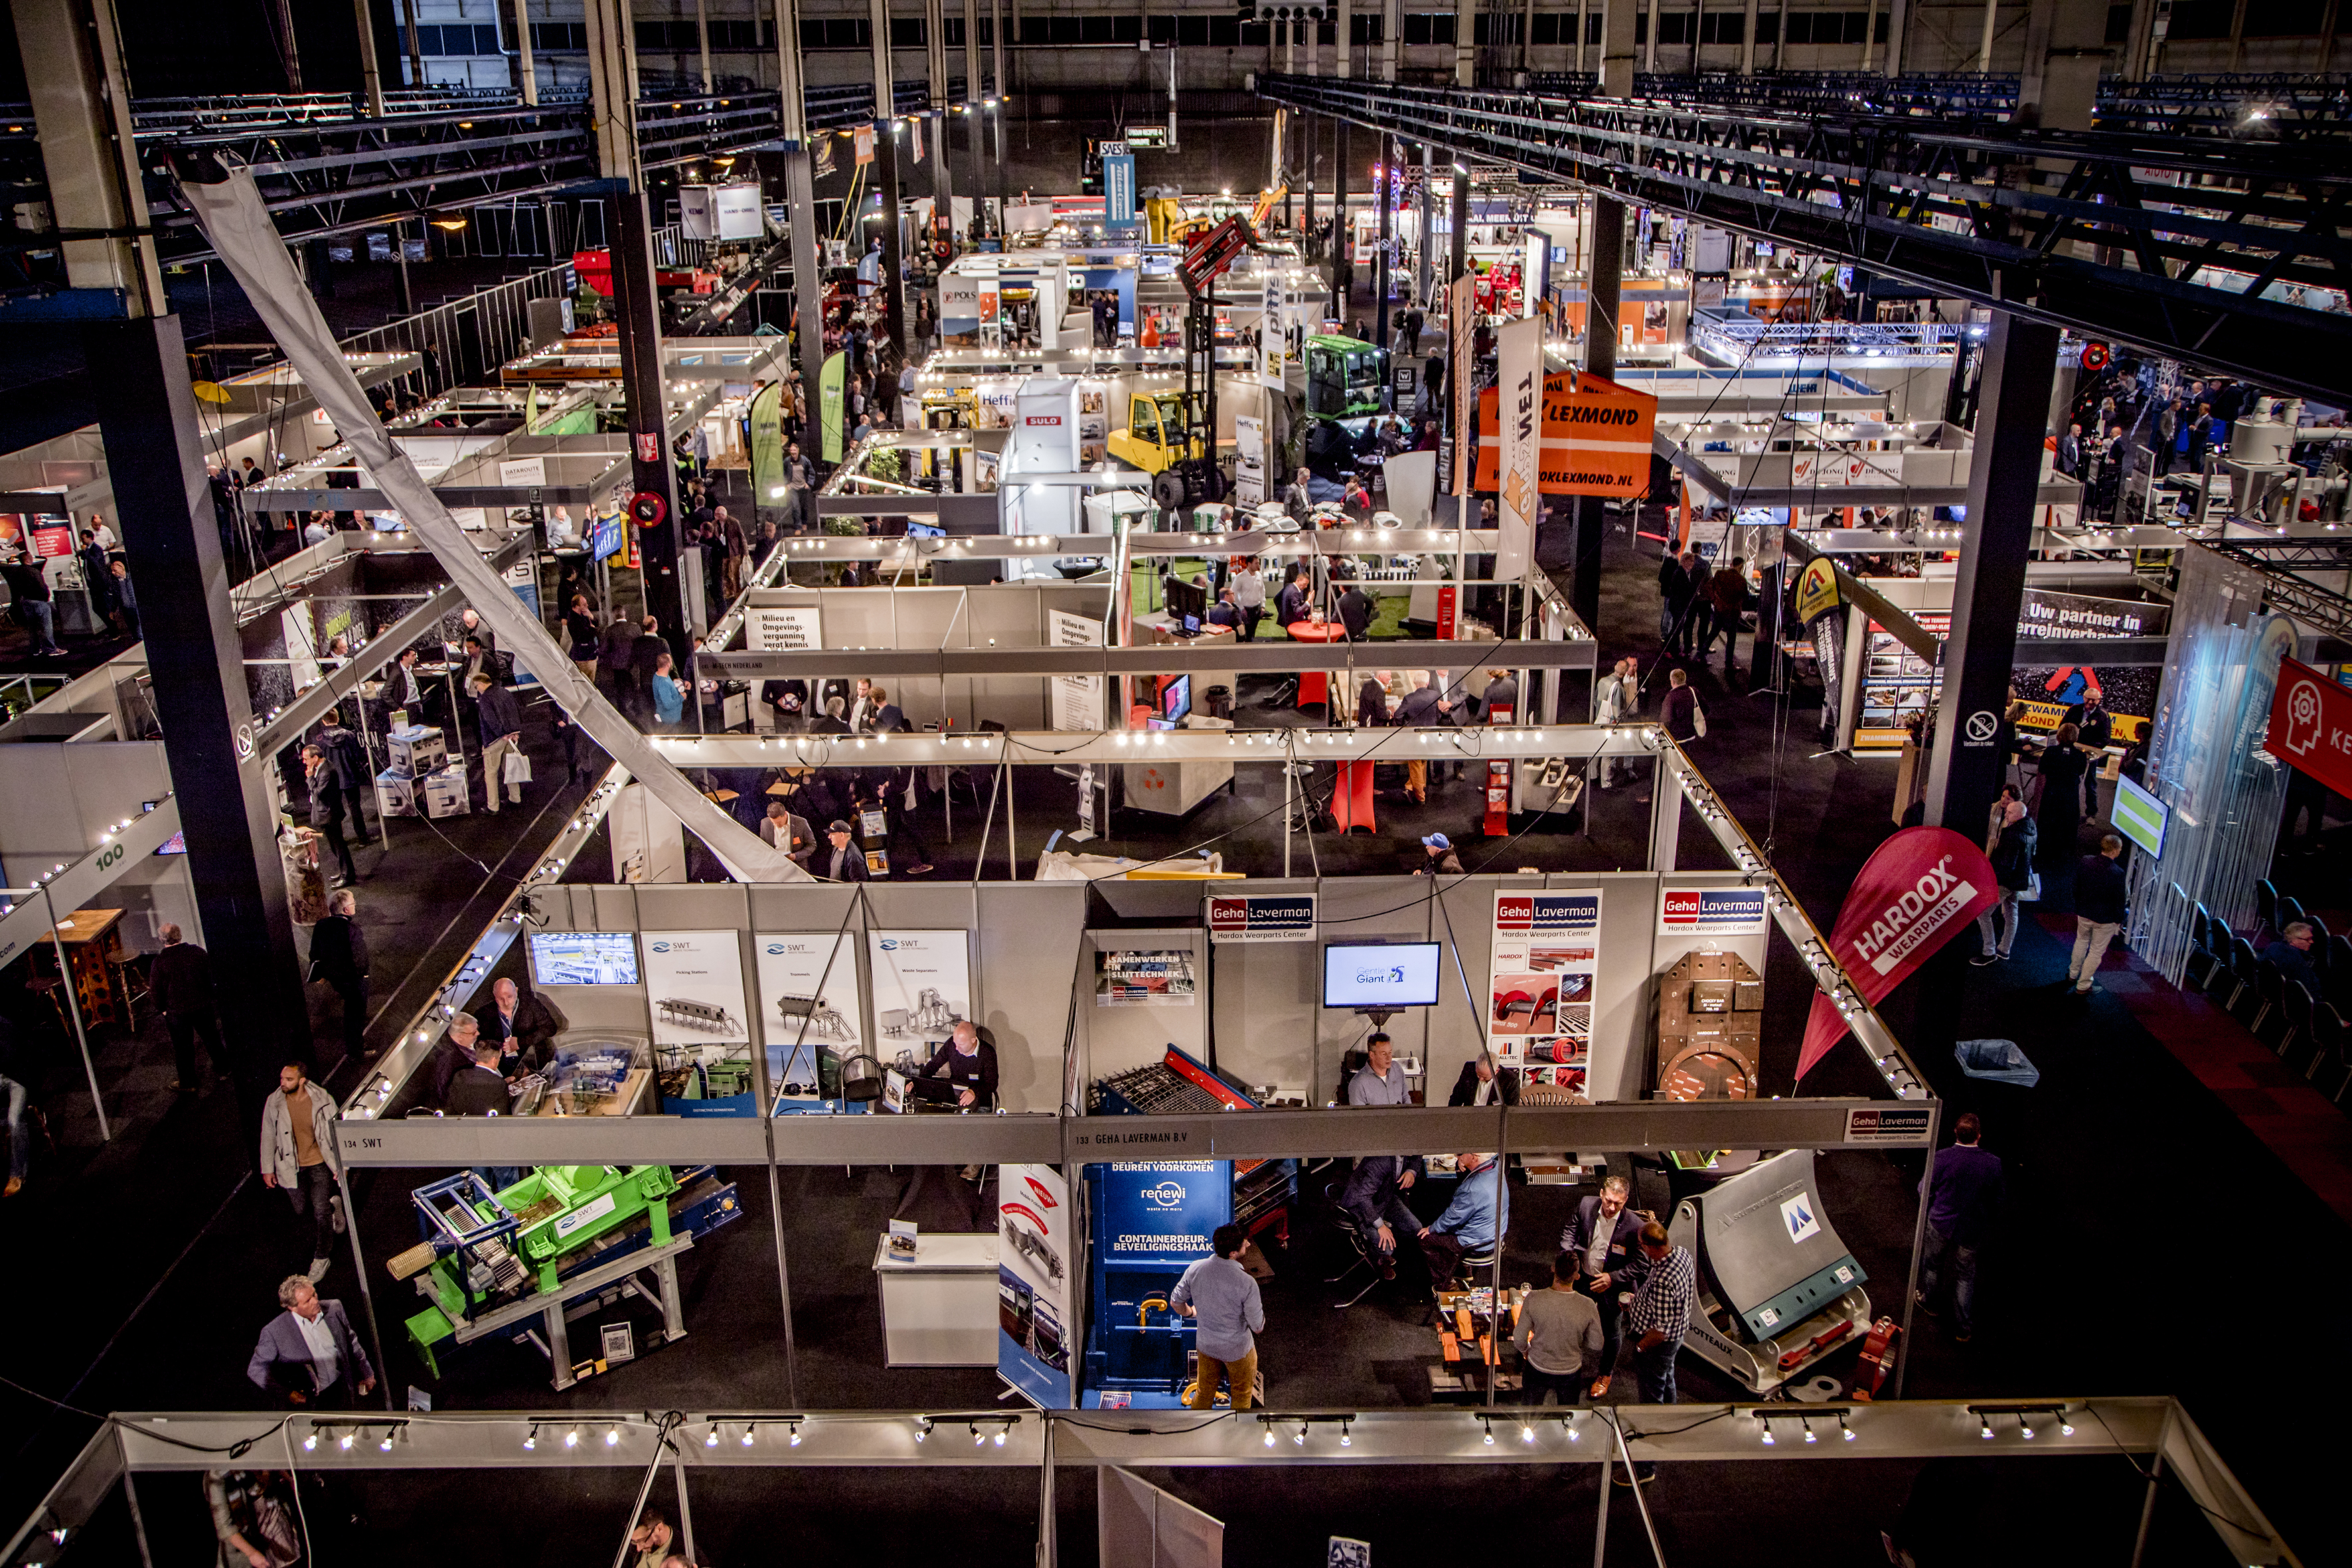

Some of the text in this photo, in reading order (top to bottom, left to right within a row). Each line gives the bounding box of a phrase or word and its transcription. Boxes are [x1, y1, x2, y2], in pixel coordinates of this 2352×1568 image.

[903, 398, 918, 410] Heffiq
[1549, 404, 1638, 426] LEXMOND
[1237, 418, 1253, 430] Heffiq
[505, 465, 539, 475] DATAROUTE
[2030, 602, 2142, 631] Uw partner in
[762, 623, 805, 632] Omgevings-
[1061, 618, 1077, 629] Milieu
[1061, 627, 1092, 642] Omgevings-
[96, 843, 124, 872] 100
[1499, 905, 1595, 918] Geha Laverman
[1666, 899, 1763, 912] Geha Laverman
[1853, 858, 1958, 961] HARDOX
[1214, 906, 1312, 919] Geha Laverman
[1888, 896, 1960, 960] WEARPARTS
[1245, 931, 1283, 940] Wearparts
[1356, 967, 1385, 975] Gentle
[1356, 975, 1385, 984] Giant
[1853, 1116, 1927, 1126] Geha Laverman
[344, 1138, 382, 1148] 134 SWT
[1075, 1133, 1188, 1144] 133 GEHA LAVERMAN B.V
[1152, 1164, 1214, 1172] VOORKOMEN
[1034, 1186, 1055, 1206] NIEUW!
[1140, 1187, 1186, 1199] renewi
[1020, 1190, 1032, 1202] Mobile
[1031, 1198, 1043, 1211] Picking
[577, 1206, 594, 1218] SWT
[1733, 1202, 1760, 1221] SOLUTION
[1119, 1234, 1208, 1243] CONTAINERDEUR-
[1113, 1243, 1214, 1252] BEVEILIGINGSHAAK
[1020, 1358, 1036, 1373] DISTINCTIVE
